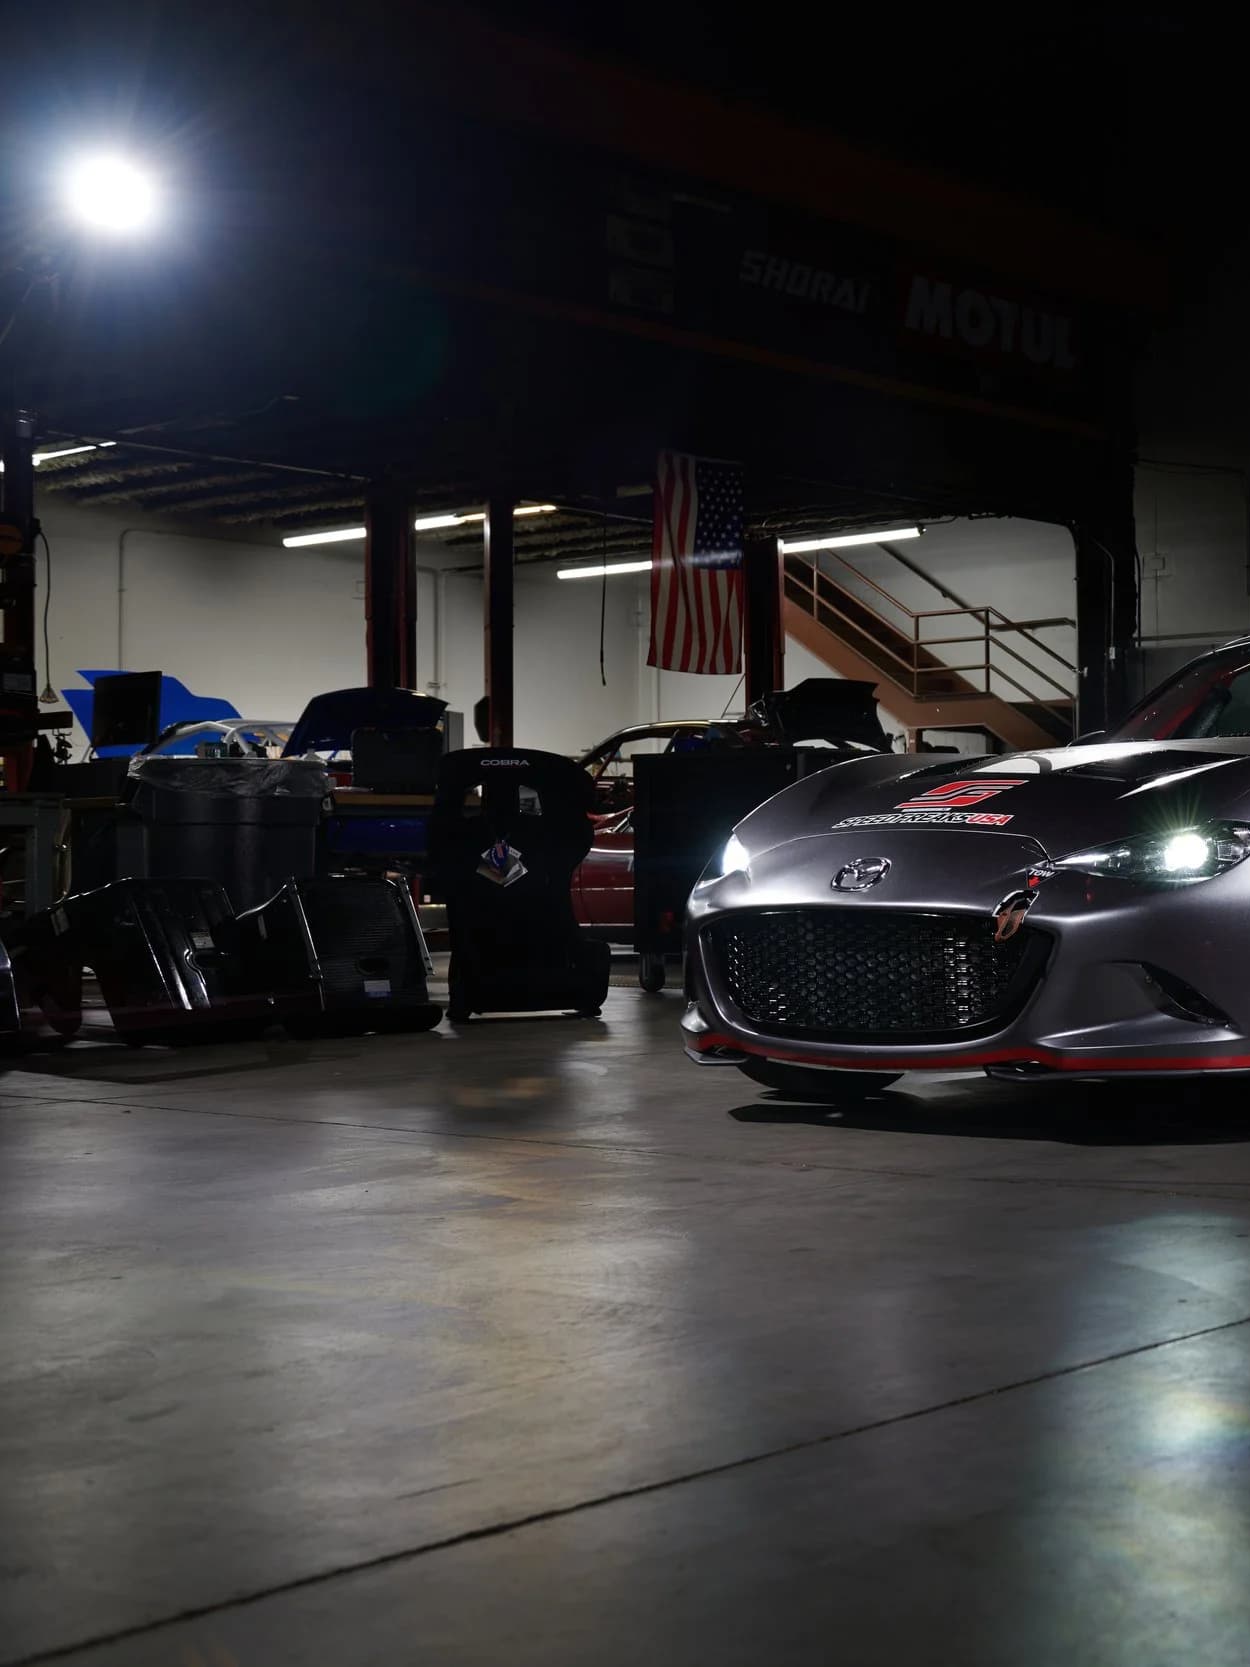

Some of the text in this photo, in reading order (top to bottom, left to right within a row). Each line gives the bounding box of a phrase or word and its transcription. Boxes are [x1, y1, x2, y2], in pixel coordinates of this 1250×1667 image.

[739, 249, 873, 314] SHORAI
[904, 273, 1080, 369] MOTUL
[480, 759, 531, 767] COBRA
[965, 812, 1015, 826] USA
[1028, 867, 1056, 878] TOW
